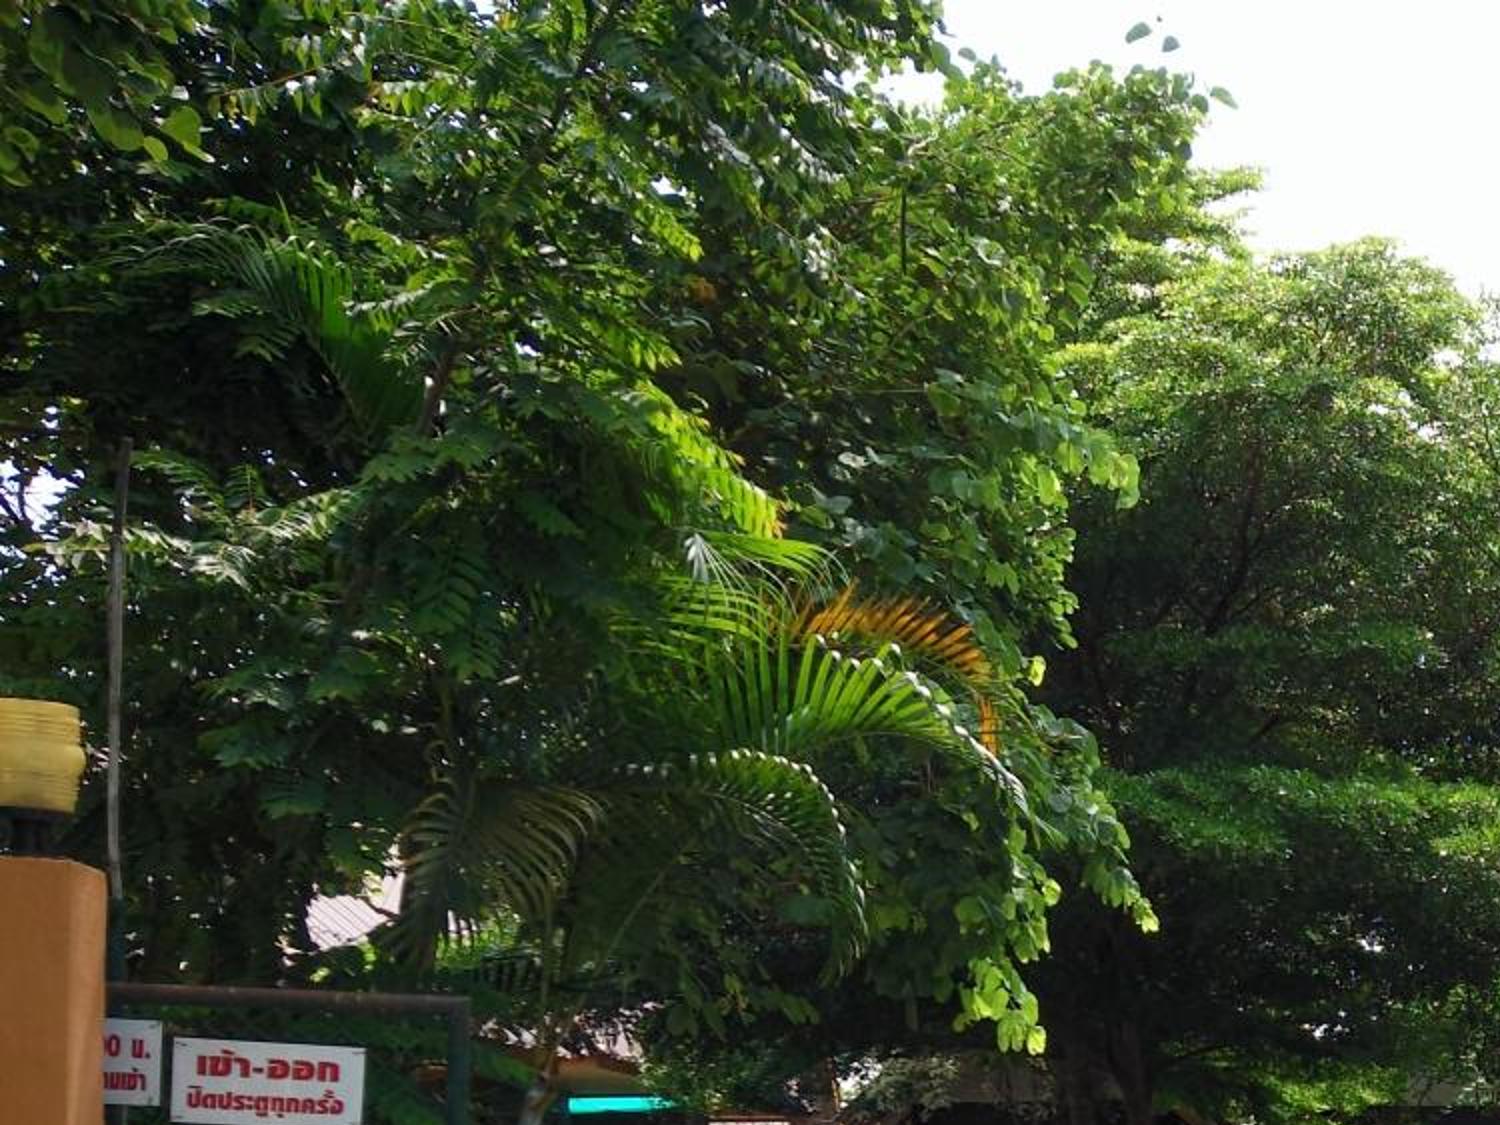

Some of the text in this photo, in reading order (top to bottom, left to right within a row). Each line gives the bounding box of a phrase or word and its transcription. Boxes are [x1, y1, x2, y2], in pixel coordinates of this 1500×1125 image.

[196, 1049, 341, 1083] เข้า-ออก
[186, 1085, 345, 1118] ปิดประตูทุกครั้ง
